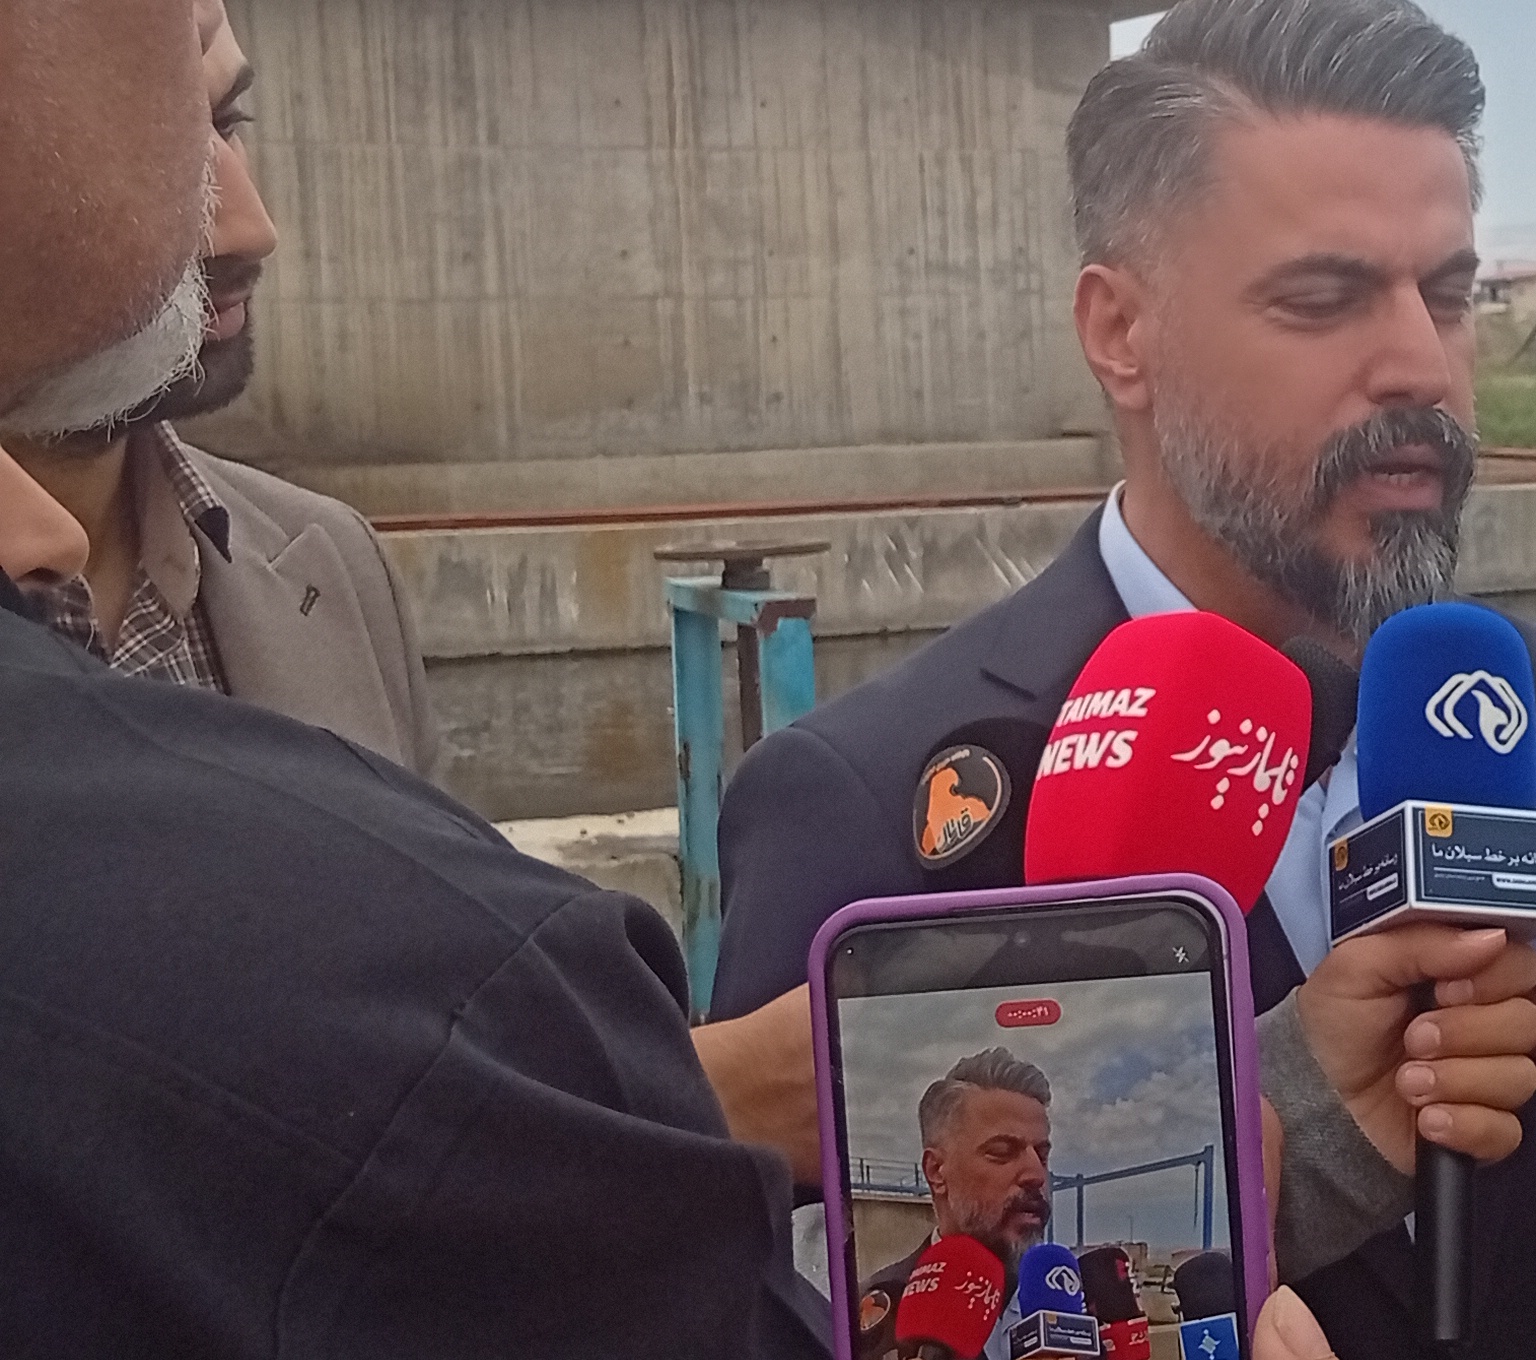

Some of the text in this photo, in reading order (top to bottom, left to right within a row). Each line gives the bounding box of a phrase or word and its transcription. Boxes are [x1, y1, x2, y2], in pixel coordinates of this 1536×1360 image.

[1056, 687, 1156, 727] TAIMAZ
[1036, 730, 1138, 781] NEWS
[1431, 842, 1444, 857] ما
[1484, 848, 1507, 862] خط
